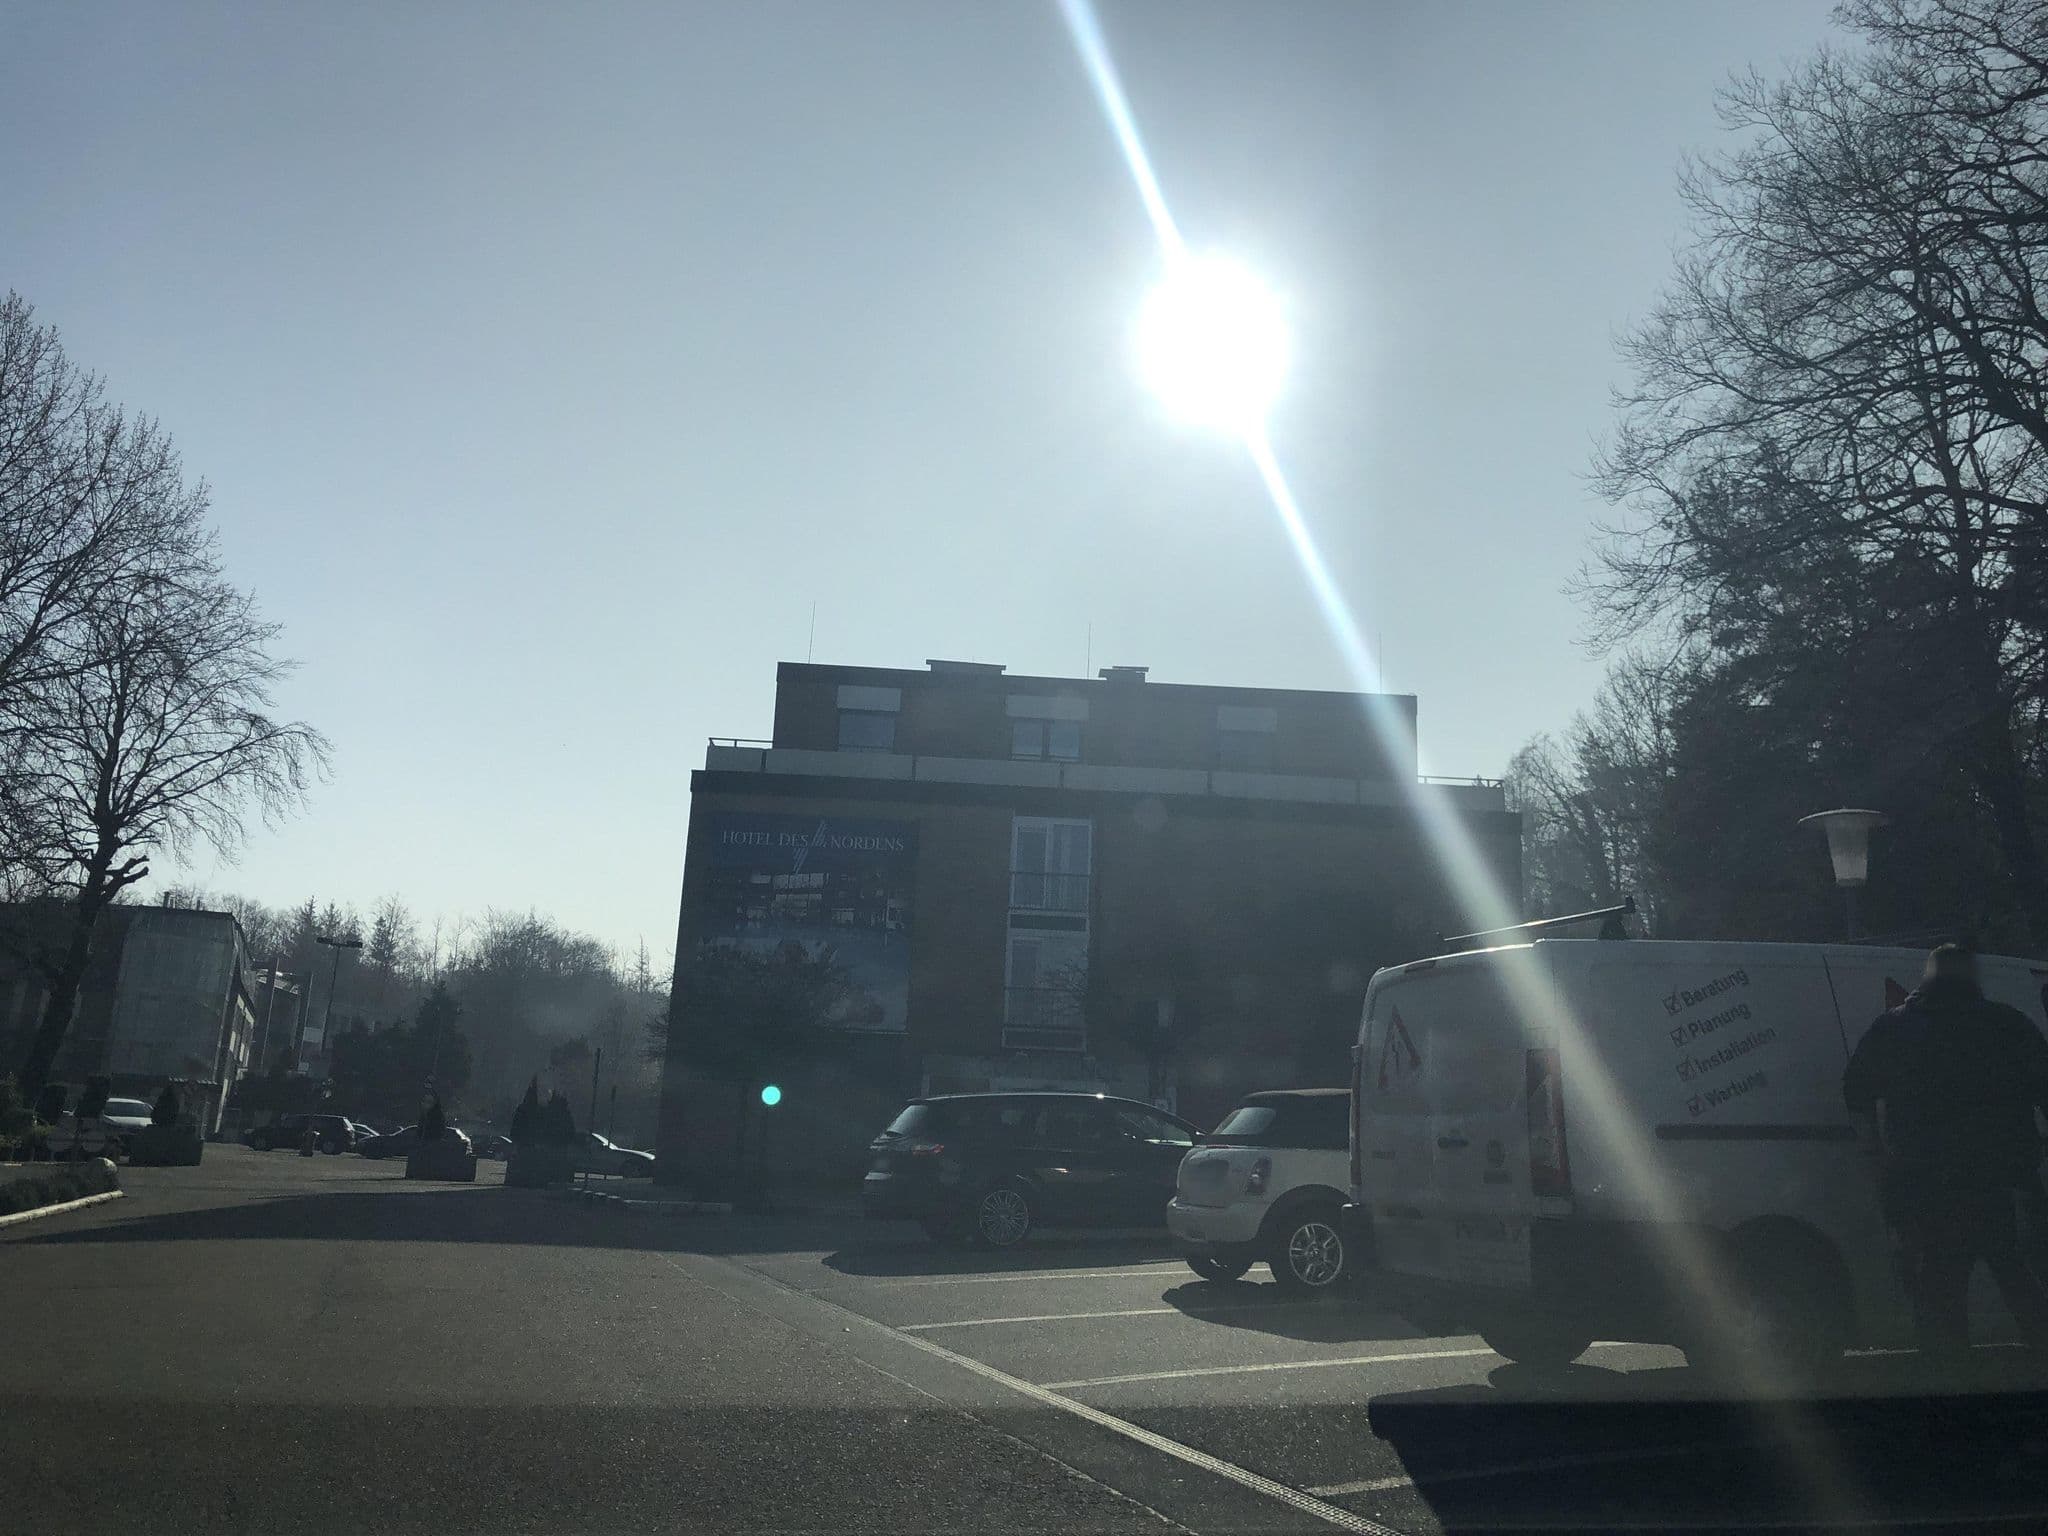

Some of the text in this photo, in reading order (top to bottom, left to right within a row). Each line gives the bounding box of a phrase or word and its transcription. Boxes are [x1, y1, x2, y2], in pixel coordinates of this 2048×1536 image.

[721, 831, 904, 851] HOTEL DES NORDENS
[1680, 968, 1749, 1007] Beratung
[1688, 1003, 1751, 1038] Planung
[1694, 1027, 1776, 1073] Installation
[1704, 1069, 1768, 1108] Wartung
